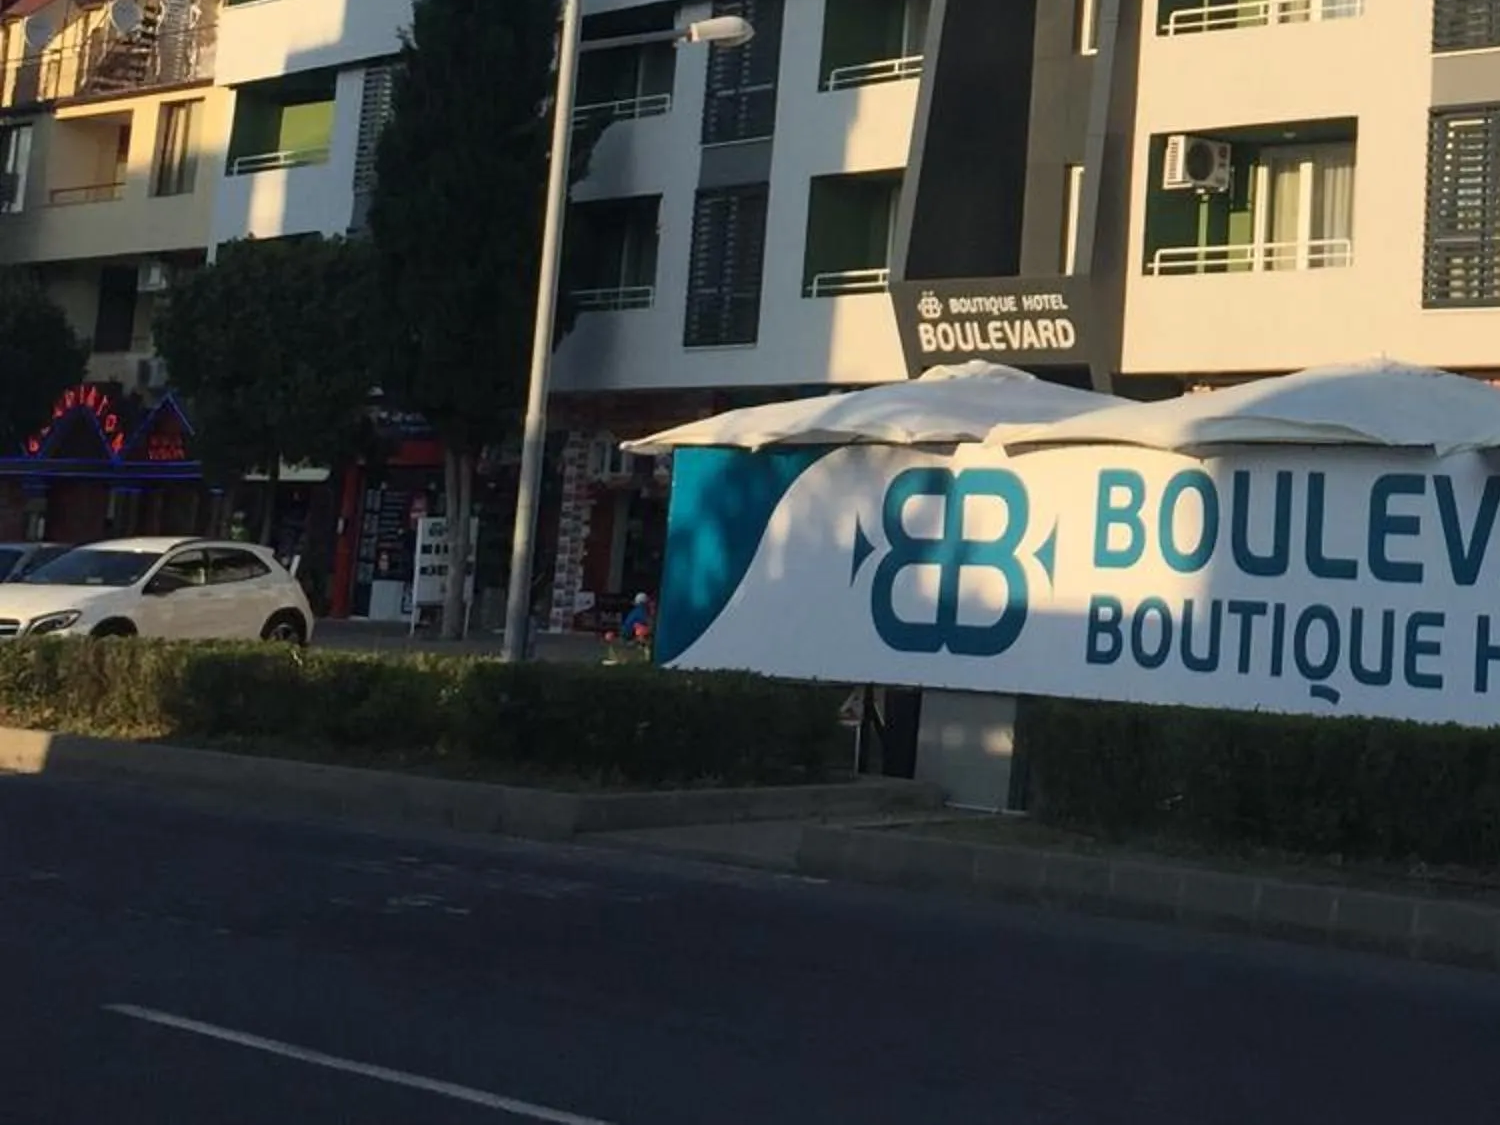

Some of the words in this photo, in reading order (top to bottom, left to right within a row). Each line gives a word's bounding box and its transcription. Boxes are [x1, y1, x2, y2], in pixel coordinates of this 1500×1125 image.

[949, 295, 1018, 315] BOUTIQUE
[1022, 294, 1069, 311] HOTEL
[918, 318, 1076, 352] BOULEVARD
[1085, 592, 1446, 706] BOUTIQUE
